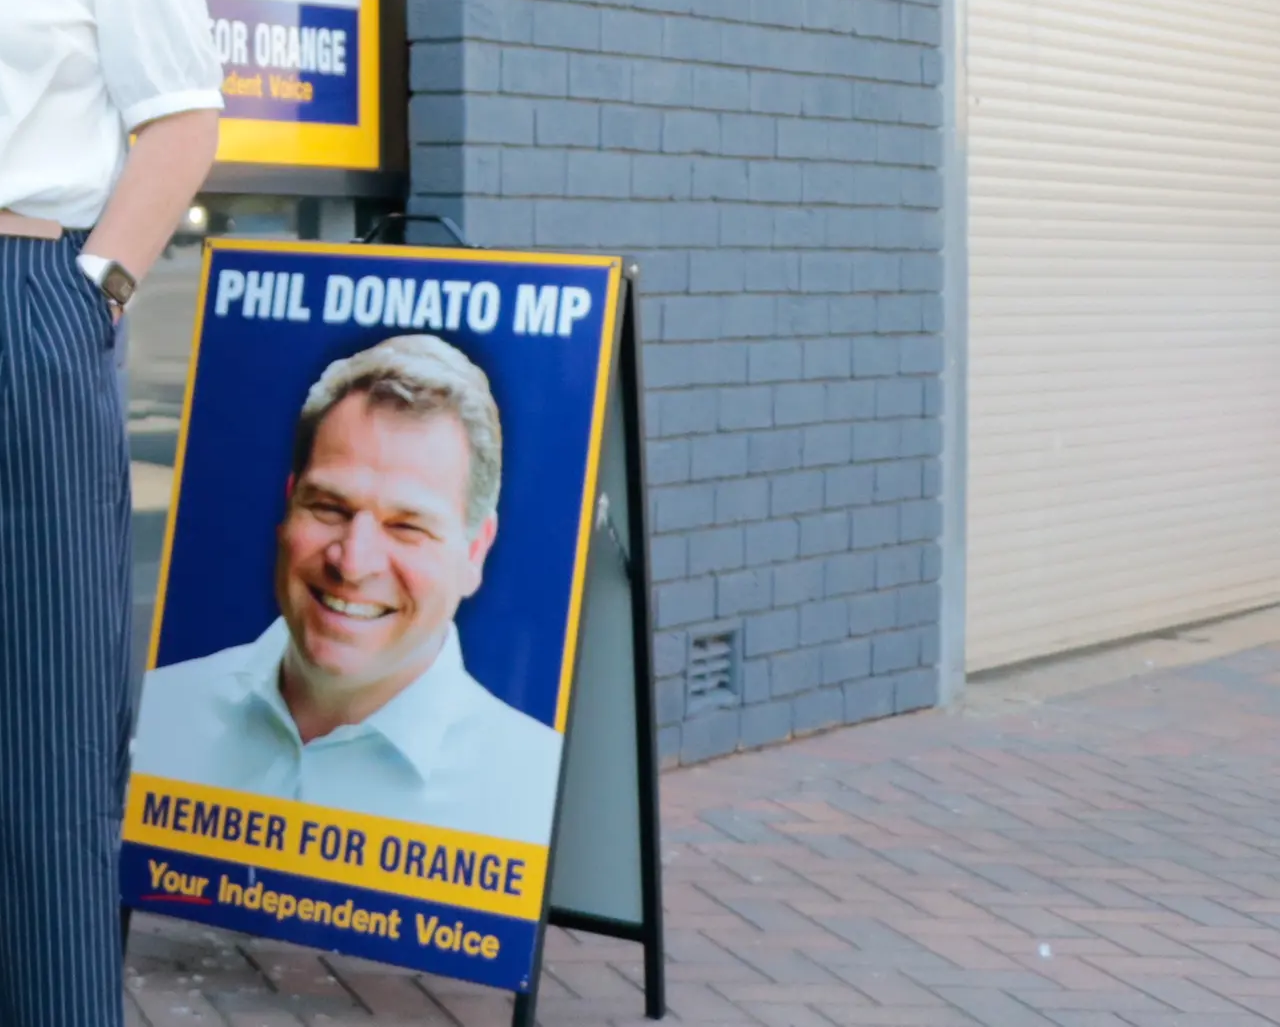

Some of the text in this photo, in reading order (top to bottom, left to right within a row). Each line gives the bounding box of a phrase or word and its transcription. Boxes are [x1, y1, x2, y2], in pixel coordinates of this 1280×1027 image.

[255, 22, 346, 76] ORANGE
[269, 75, 314, 102] Voice
[214, 268, 592, 337] PHIL DONATO MP
[141, 790, 526, 897] MEMBER FOR ORANGE
[147, 859, 500, 960] Your Independent Voice
